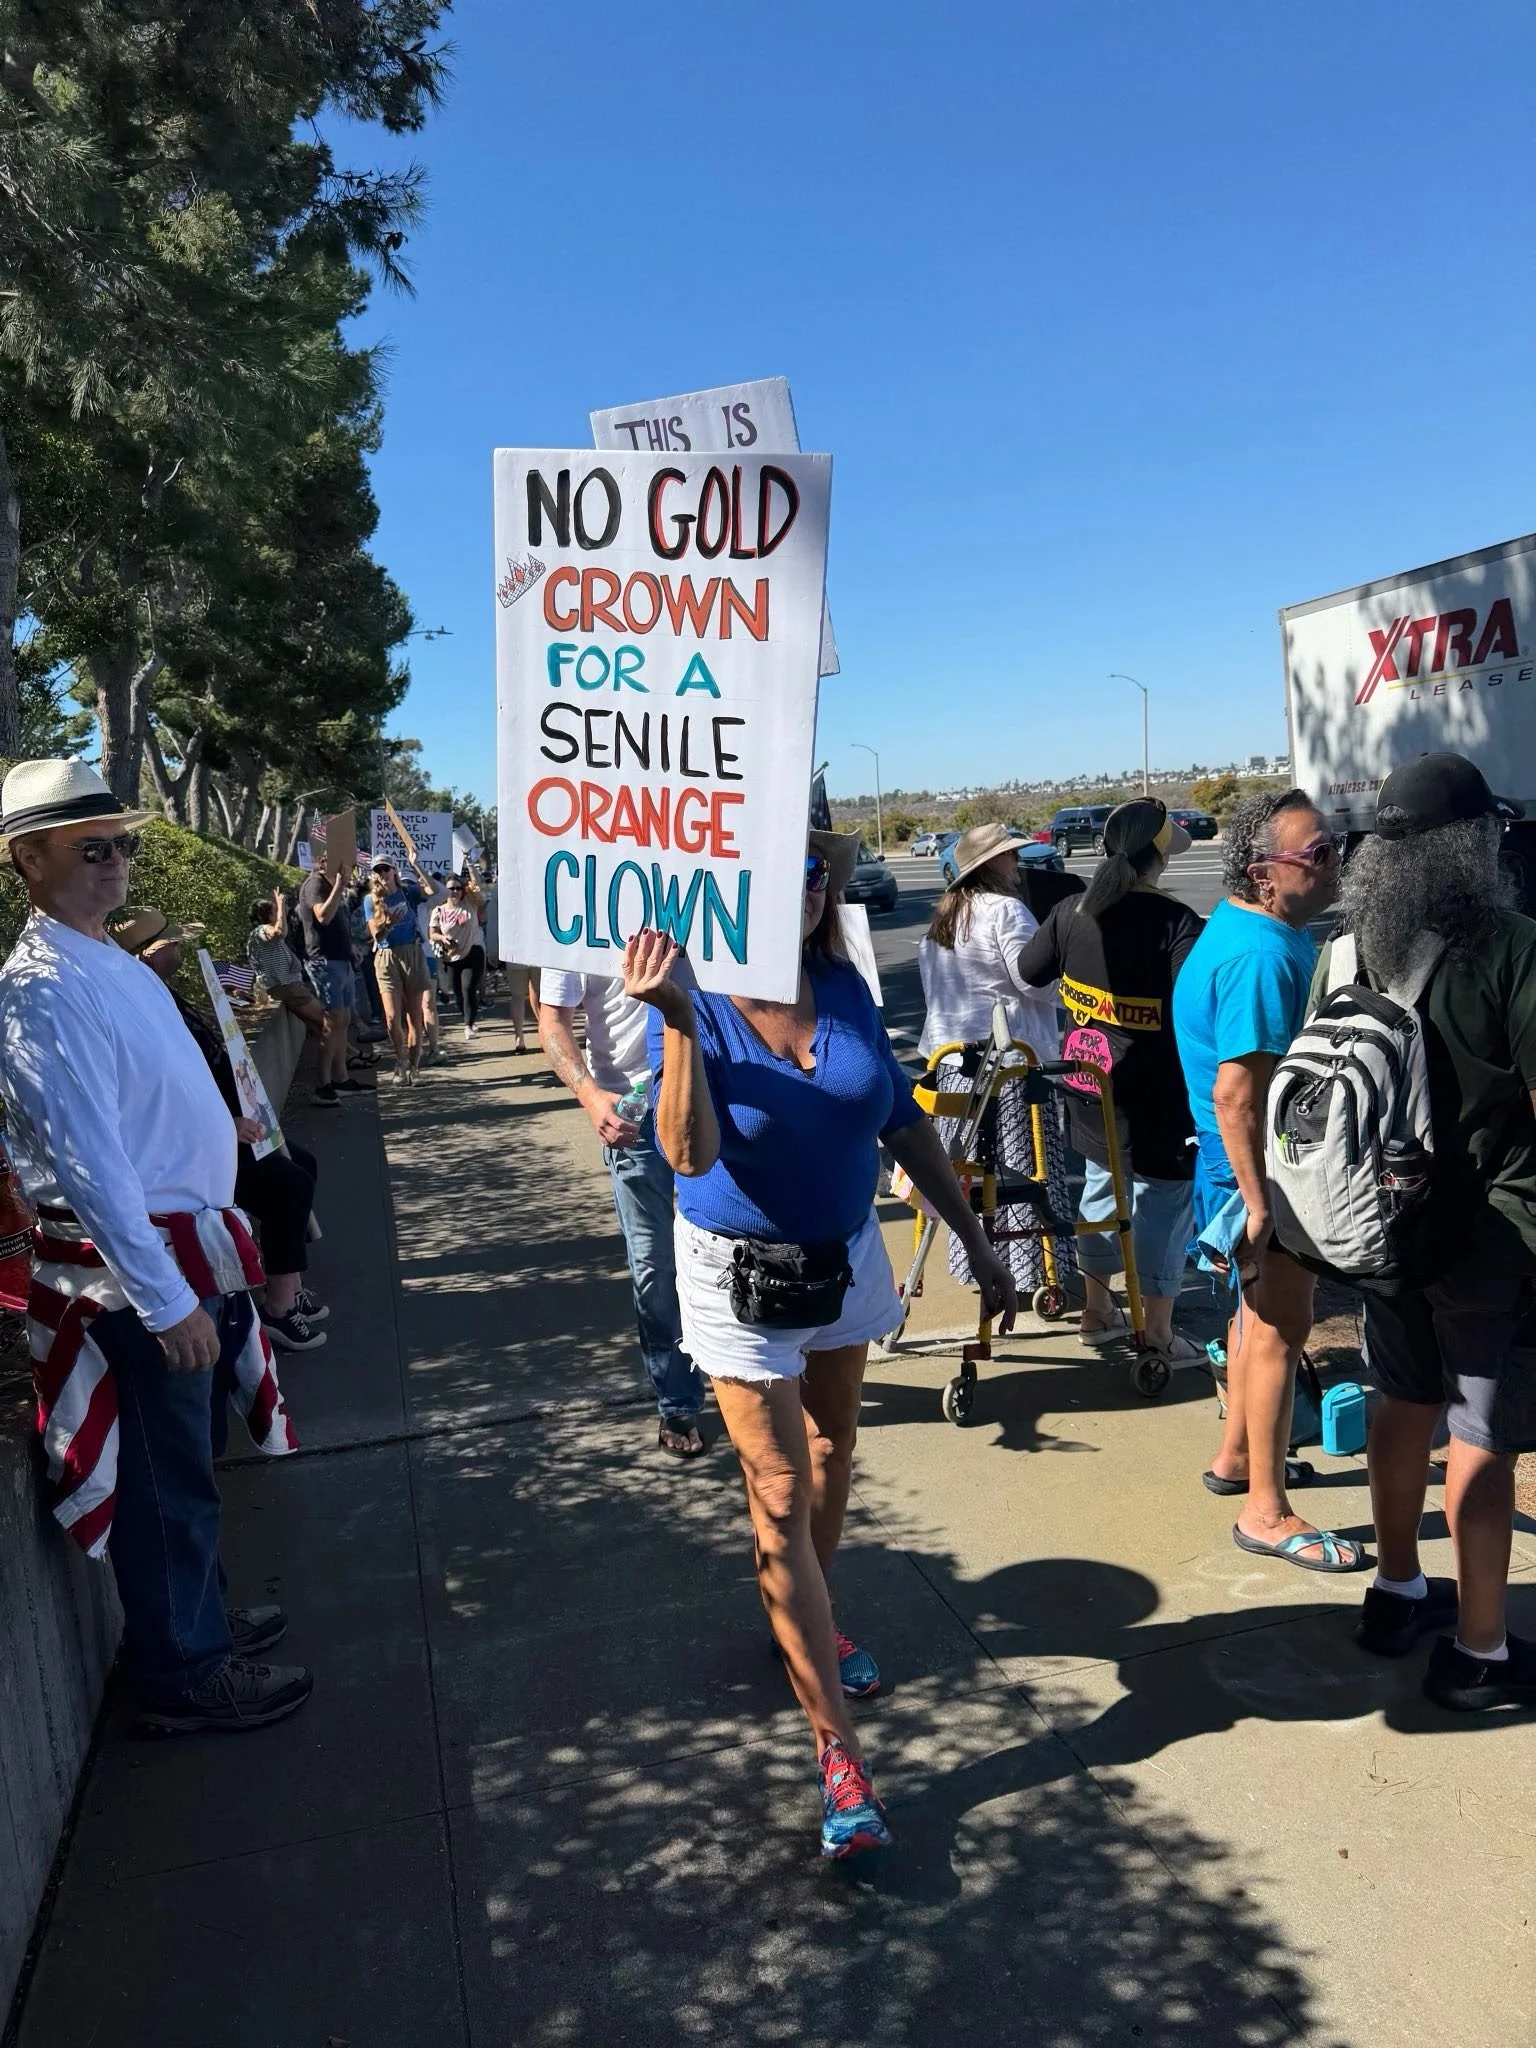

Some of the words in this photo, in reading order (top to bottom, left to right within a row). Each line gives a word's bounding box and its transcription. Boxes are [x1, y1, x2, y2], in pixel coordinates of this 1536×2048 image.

[614, 416, 692, 452] THIS
[721, 402, 758, 448] IS
[526, 467, 622, 550] NO
[647, 465, 801, 560] GOLD
[543, 566, 770, 641] CROWN
[547, 642, 650, 692] FOR
[675, 652, 721, 699] A
[1355, 598, 1519, 705] XTRA
[1410, 667, 1533, 701] LEASE
[540, 702, 746, 780] SENILE
[528, 777, 745, 859] ORANGE
[1328, 780, 1382, 796] xtralease.co
[544, 850, 752, 965] CLOWN
